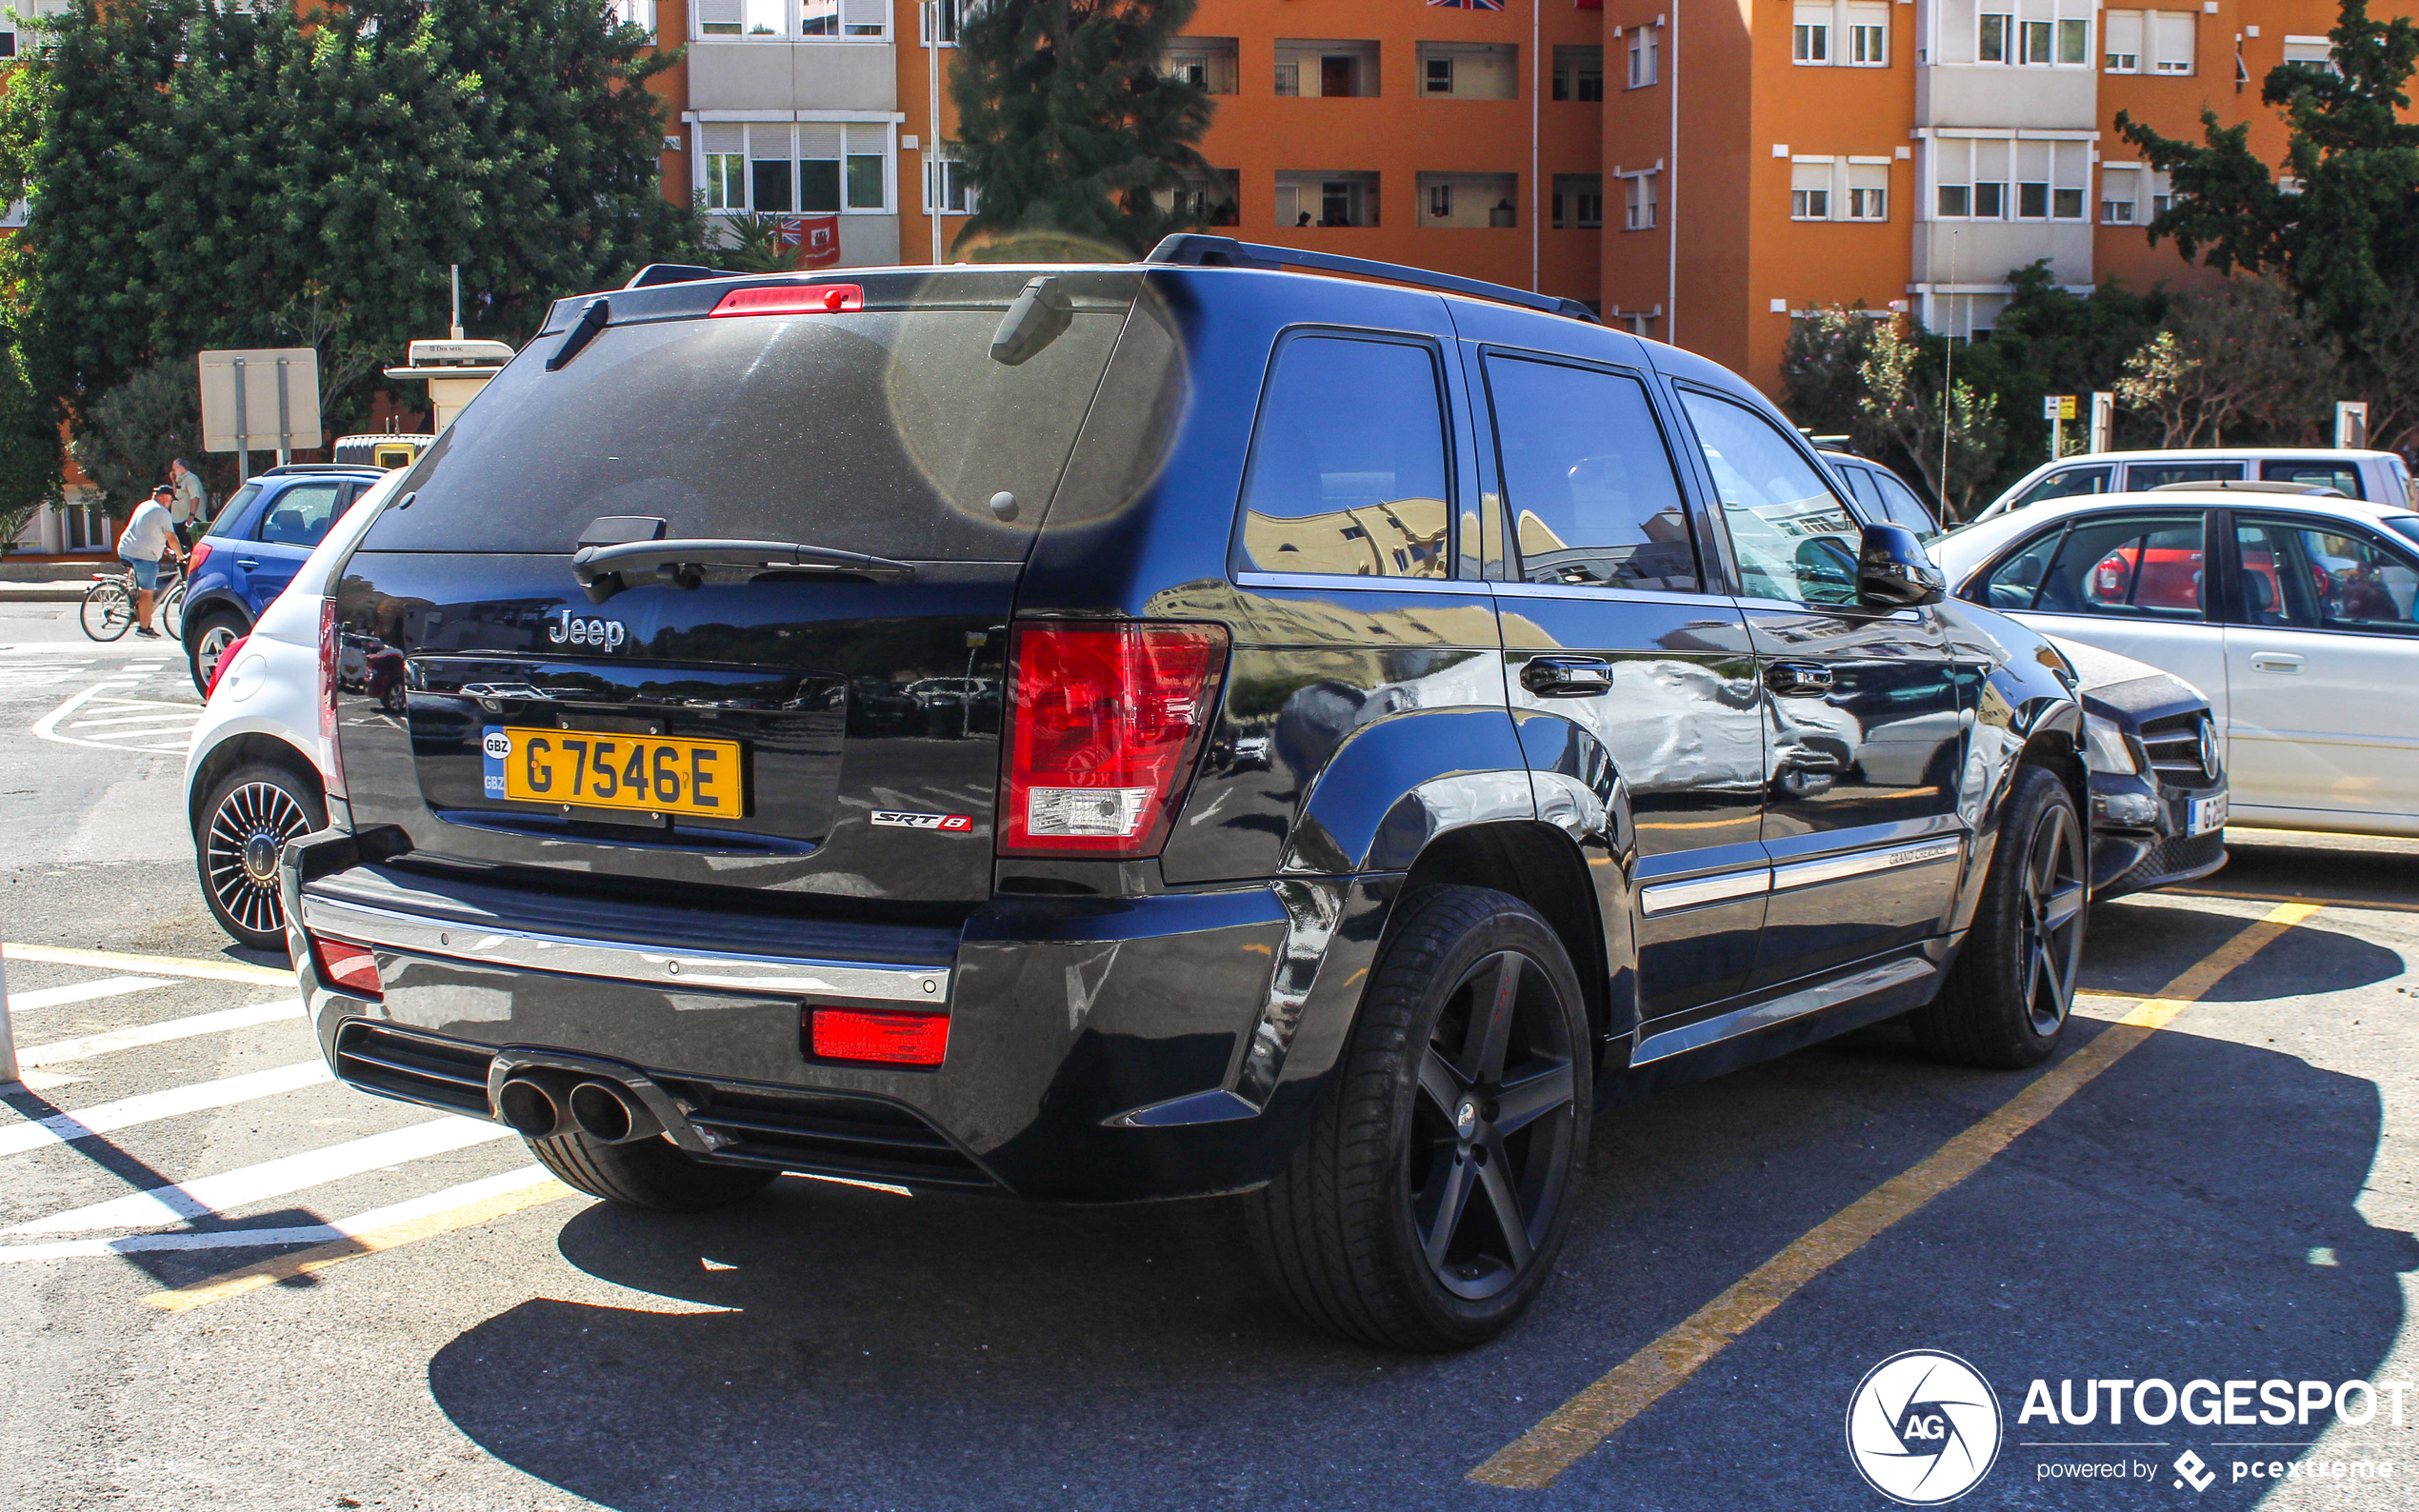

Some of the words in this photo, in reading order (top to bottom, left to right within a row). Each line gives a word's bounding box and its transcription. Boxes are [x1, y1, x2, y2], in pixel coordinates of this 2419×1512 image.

[550, 609, 625, 652] Jeep
[487, 739, 509, 752] GBZ
[485, 776, 505, 790] GBZ
